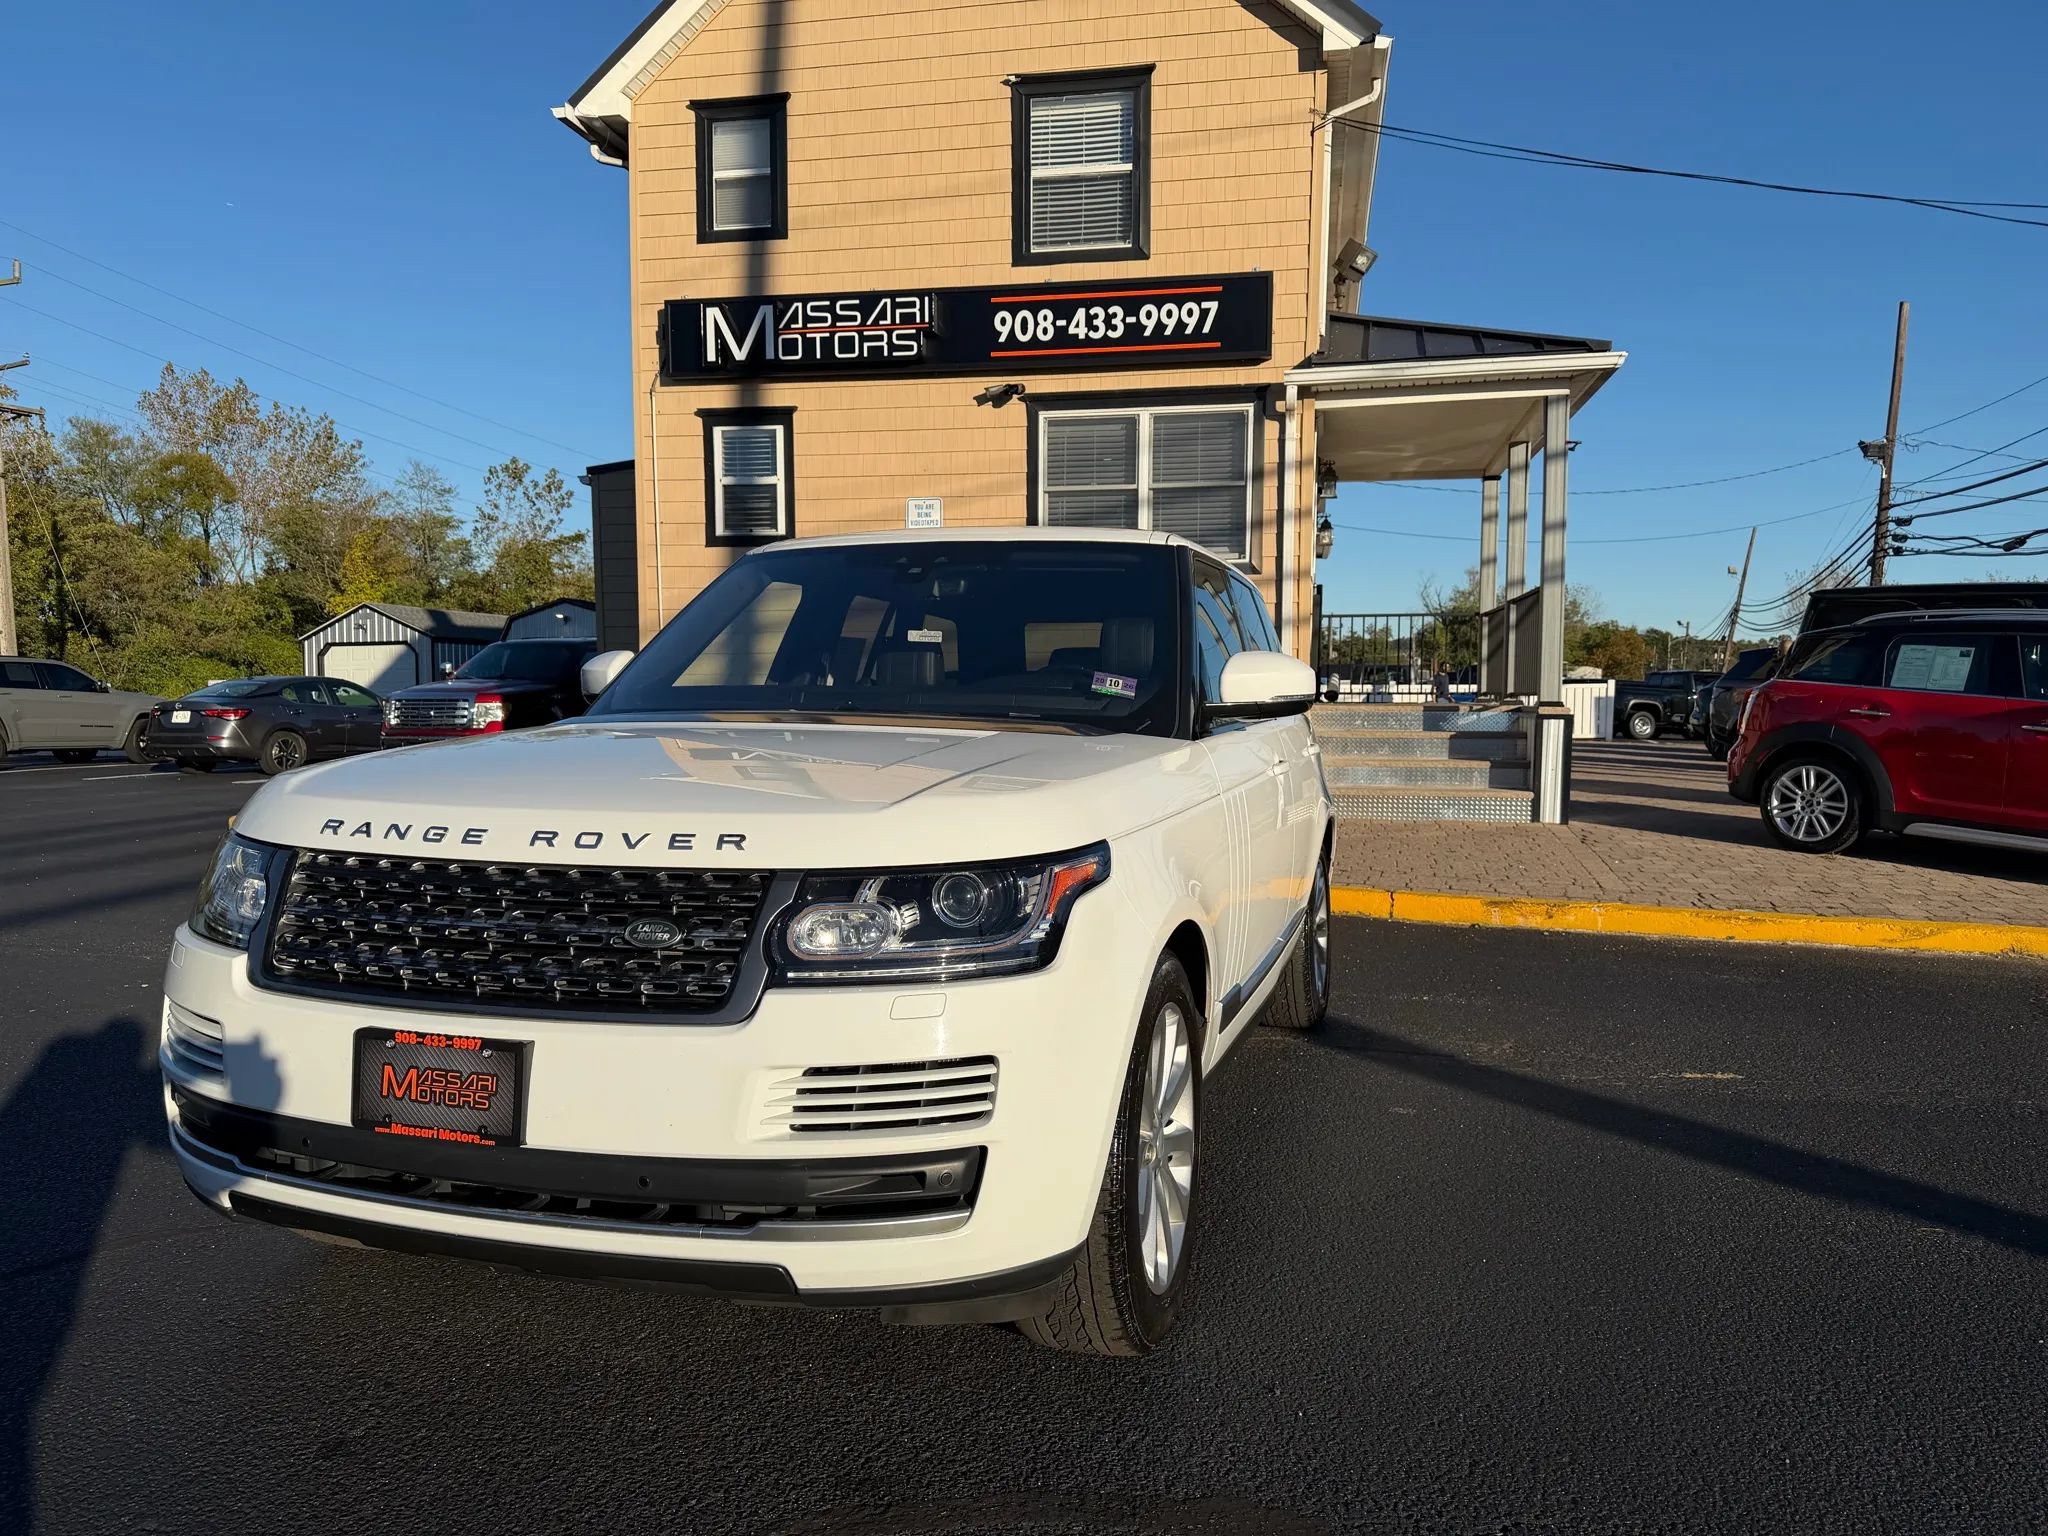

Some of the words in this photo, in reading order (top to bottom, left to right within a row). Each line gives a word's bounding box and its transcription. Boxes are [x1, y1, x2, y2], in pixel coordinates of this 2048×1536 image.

[993, 301, 1219, 342] 908-433-9997
[1108, 679, 1120, 688] 10
[320, 818, 489, 845] RANGE
[529, 830, 747, 851] ROVER
[394, 1031, 482, 1050] 908-433-9997
